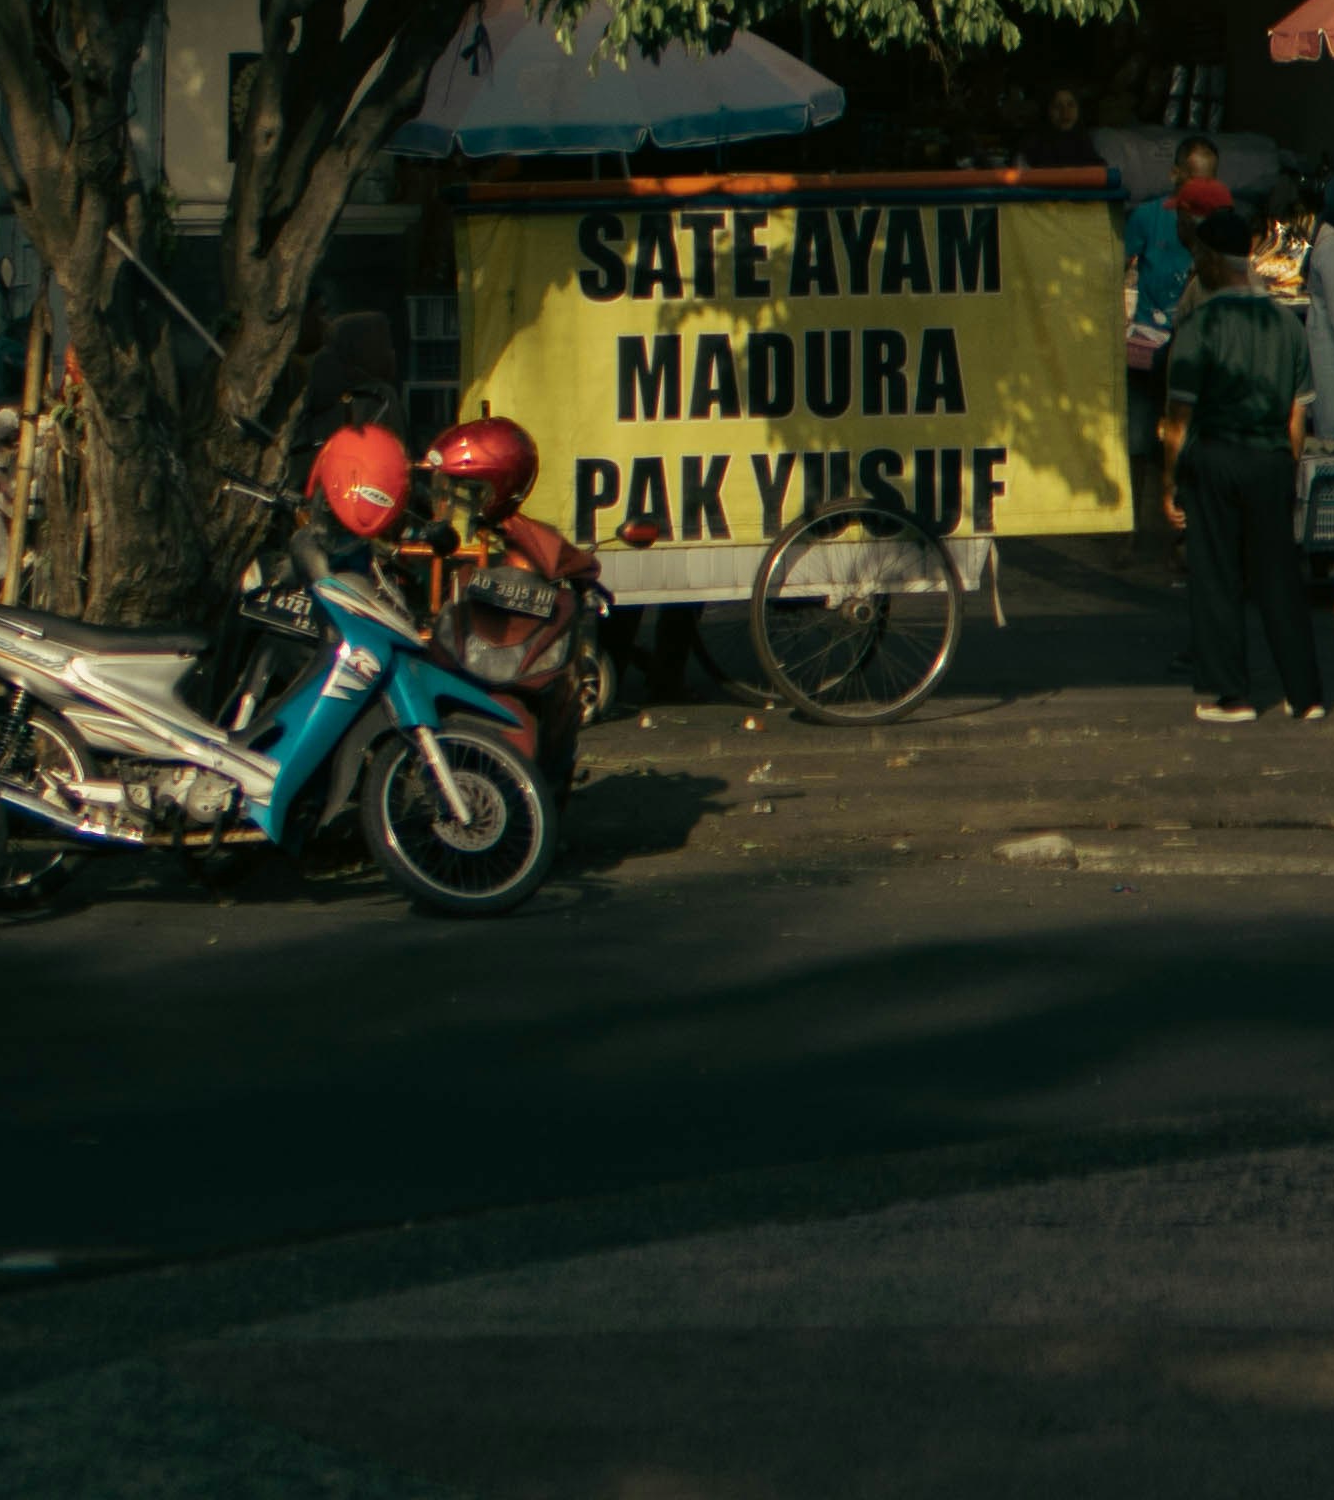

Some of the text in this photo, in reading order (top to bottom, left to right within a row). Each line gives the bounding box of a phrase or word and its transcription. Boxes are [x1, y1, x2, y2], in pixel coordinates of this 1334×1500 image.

[577, 204, 1002, 302] SATE AYAM
[616, 327, 967, 422] MADURA
[574, 447, 1008, 545] PAK YUSUF
